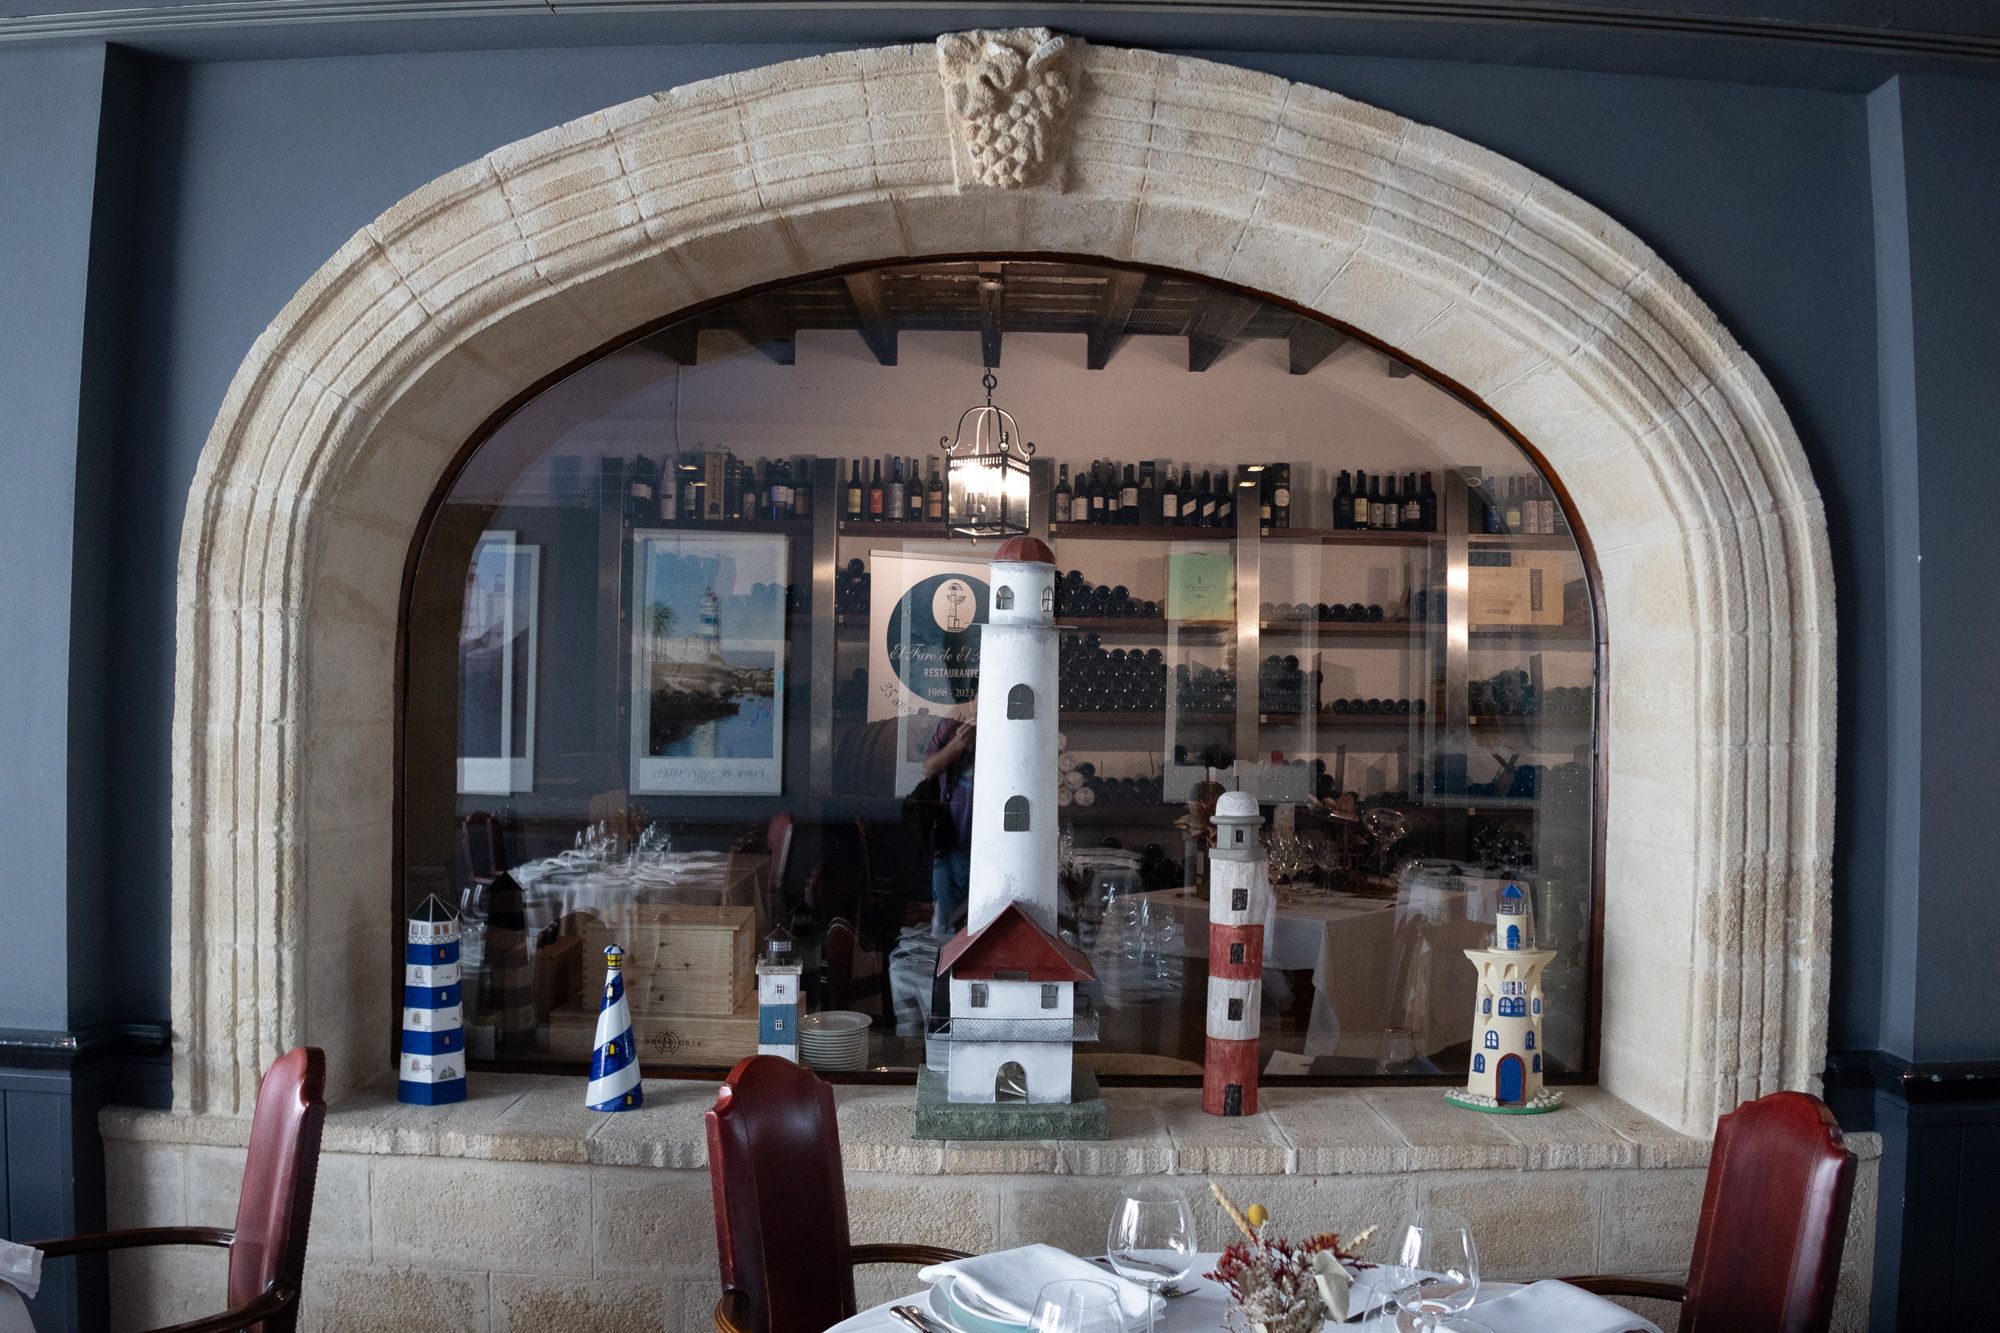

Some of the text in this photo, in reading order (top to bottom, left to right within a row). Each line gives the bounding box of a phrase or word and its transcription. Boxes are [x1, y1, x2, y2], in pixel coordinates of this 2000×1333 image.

[890, 642, 906, 660] El
[905, 643, 937, 661] Faro
[940, 647, 953, 660] de
[956, 645, 972, 662] El
[924, 667, 979, 678] RESTAURANTE
[928, 687, 948, 696] 1988
[955, 687, 974, 697] 2023
